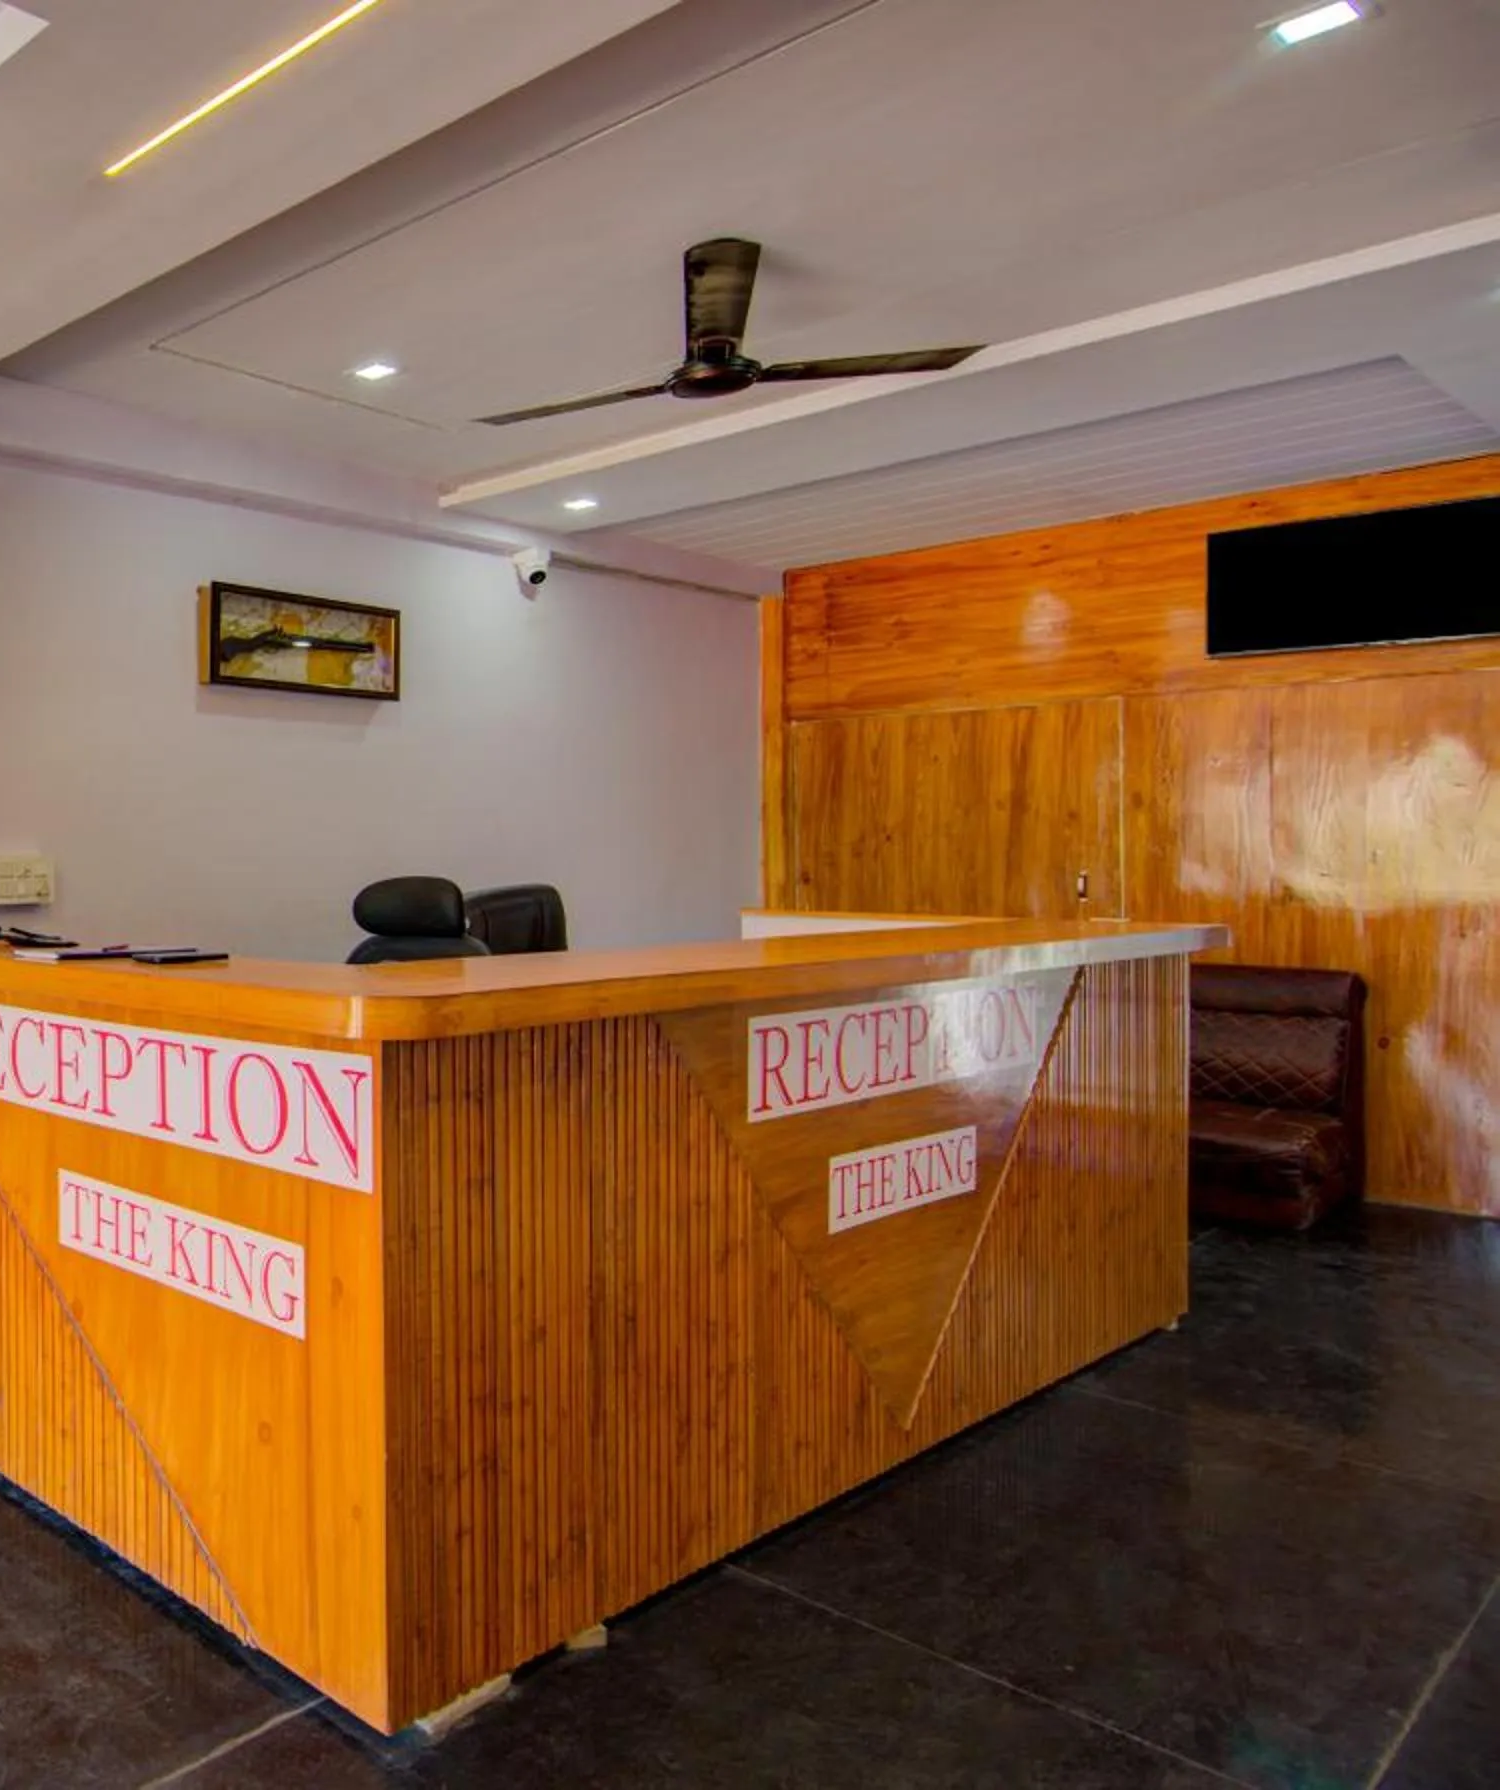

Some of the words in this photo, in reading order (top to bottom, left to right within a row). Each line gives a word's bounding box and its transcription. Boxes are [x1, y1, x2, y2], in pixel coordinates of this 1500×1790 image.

[753, 985, 1040, 1113] RECEPON
[832, 1155, 895, 1218] THE
[905, 1136, 974, 1200] KING
[64, 1182, 151, 1267] THE
[165, 1214, 298, 1323] KING
